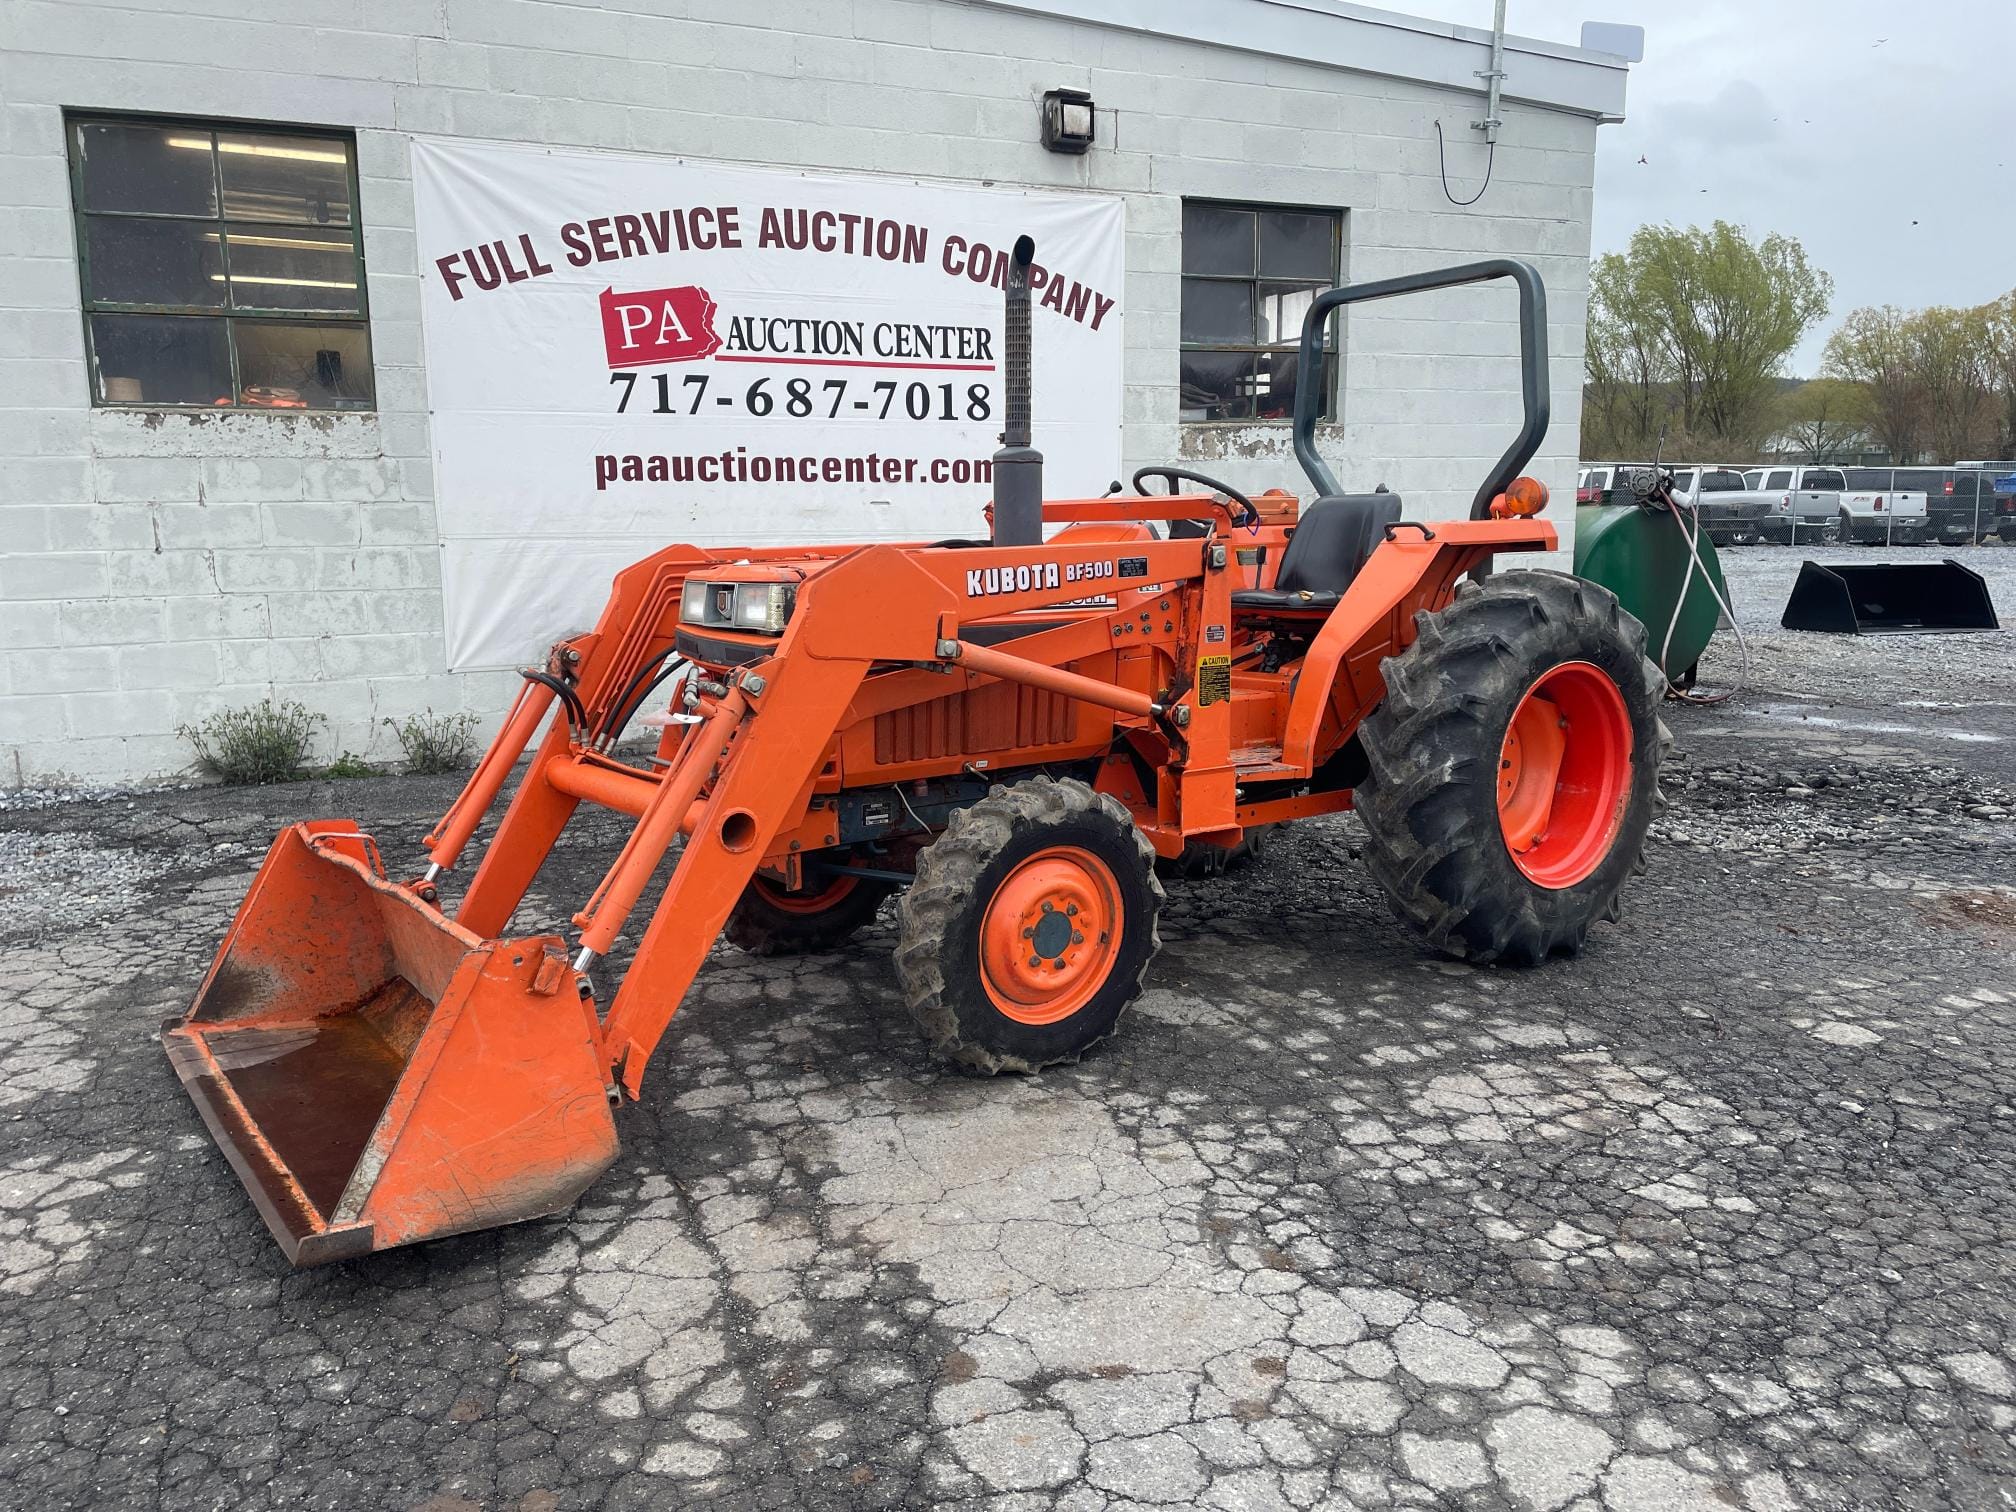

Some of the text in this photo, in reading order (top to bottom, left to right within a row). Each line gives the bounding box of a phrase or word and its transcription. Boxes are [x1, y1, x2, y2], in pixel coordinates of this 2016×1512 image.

[436, 233, 554, 302] FULL
[561, 207, 742, 268] SERVICE
[758, 207, 928, 264] AUCTION
[614, 299, 994, 361] PA AUCTION CENTER
[609, 372, 992, 422] 717-687-7018
[595, 446, 993, 490] paauctioncenter.com
[966, 562, 1060, 597] KUBOTA
[1066, 560, 1113, 582] BF500
[1208, 656, 1229, 665] CAUTION
